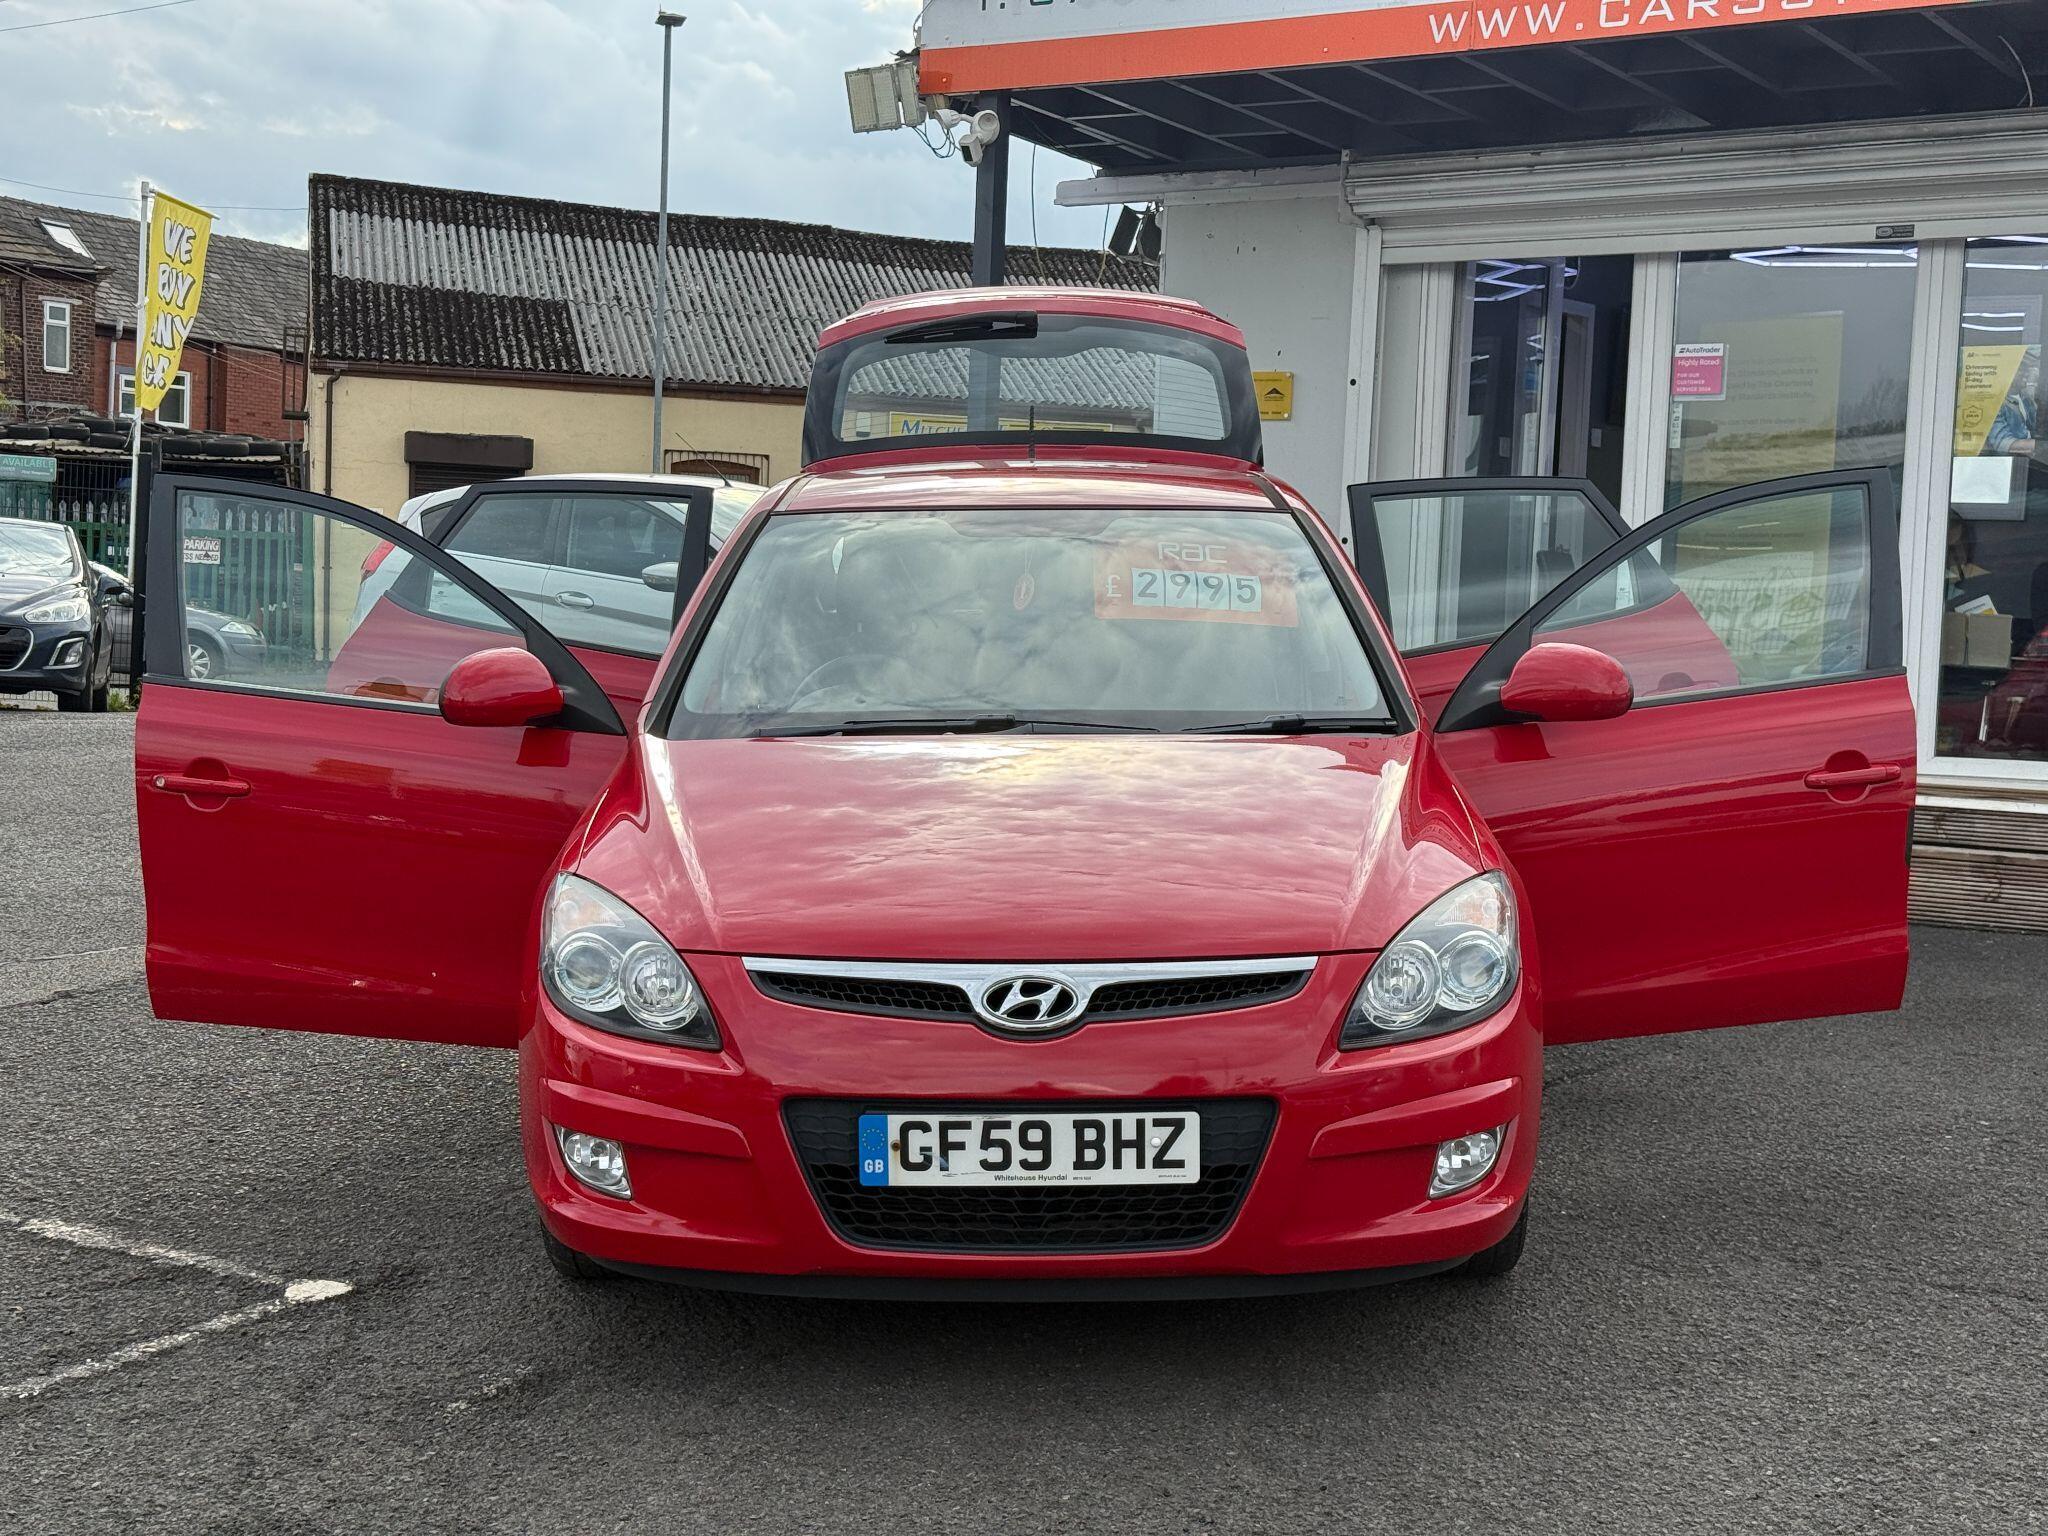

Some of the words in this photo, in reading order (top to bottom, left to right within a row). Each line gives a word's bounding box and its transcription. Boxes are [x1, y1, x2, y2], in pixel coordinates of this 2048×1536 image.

[158, 262, 196, 310] BUY
[1677, 359, 1699, 367] Highly
[1699, 358, 1720, 366] Rated
[2, 457, 55, 469] AVAILABLE
[184, 539, 220, 551] PARKING
[900, 1119, 1052, 1171] GF59
[1073, 1117, 1186, 1171] BHZ
[864, 1159, 885, 1174] GB
[994, 1174, 1036, 1182] Whitehouse
[1038, 1174, 1068, 1182] Hyundai
